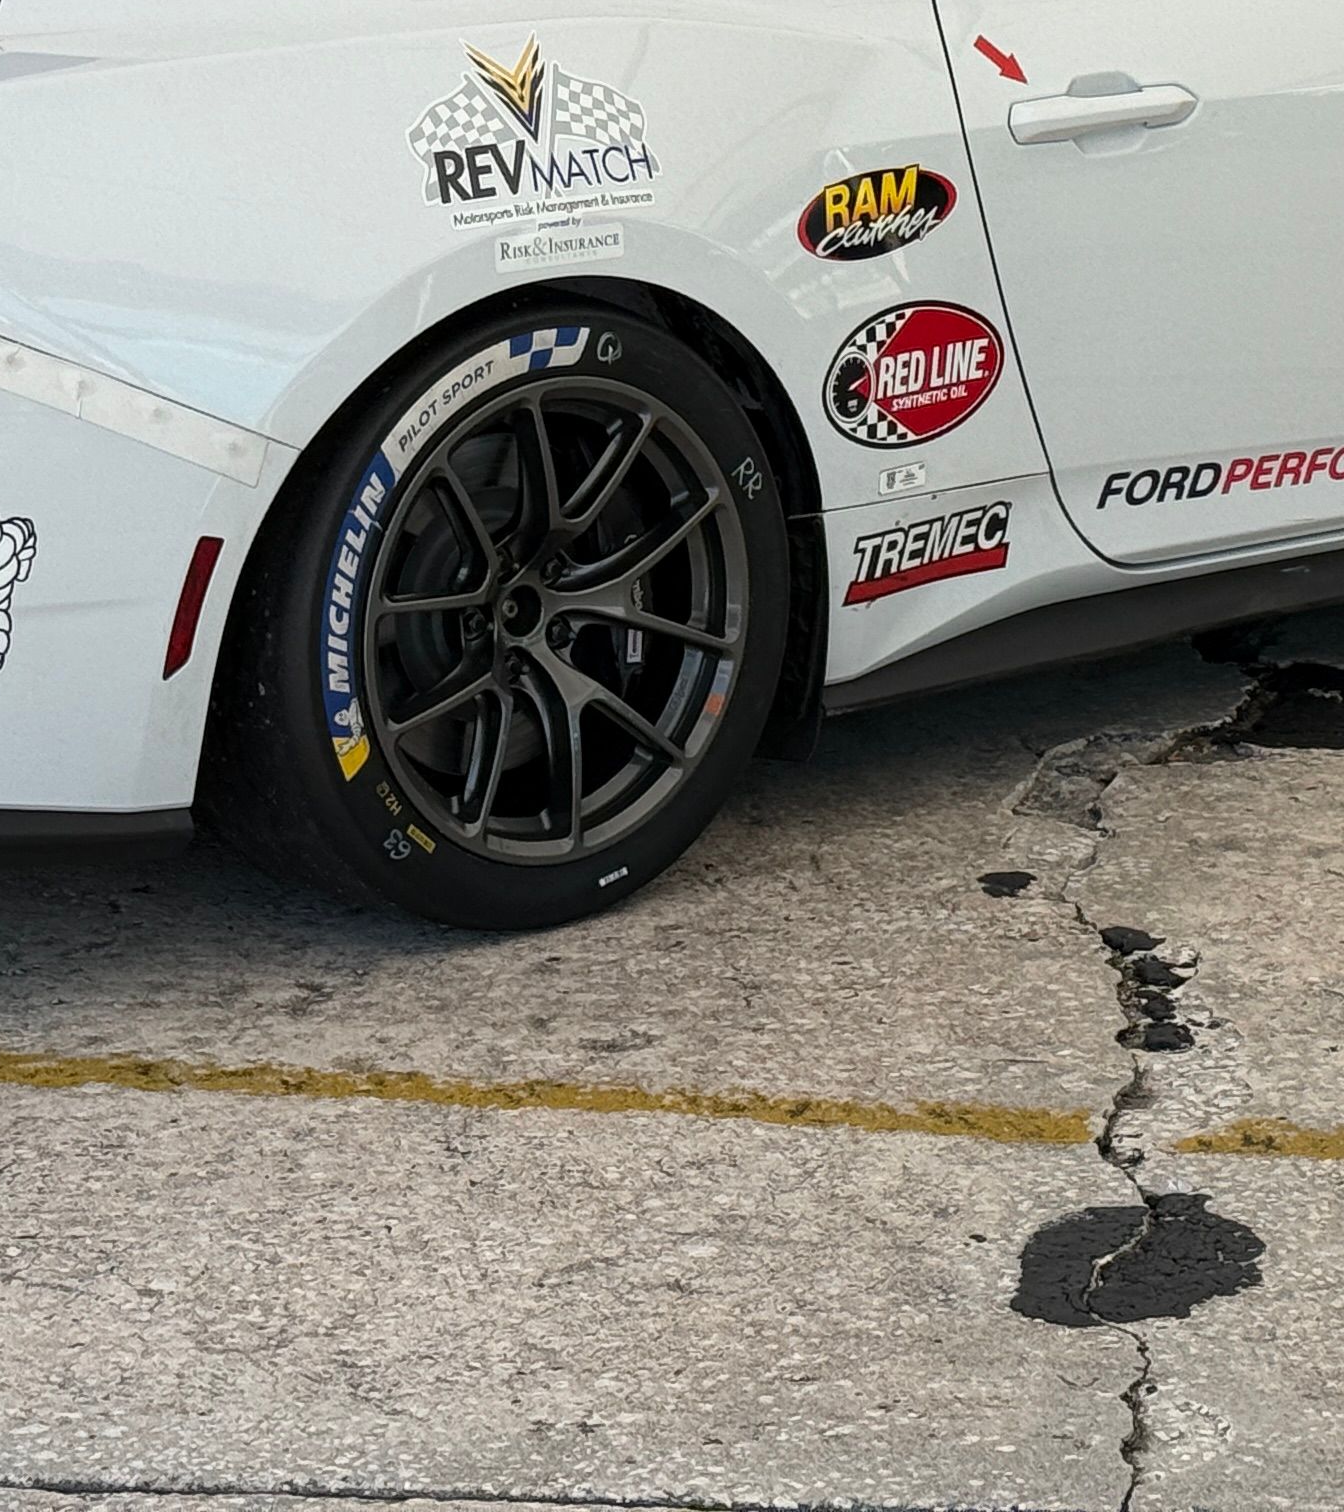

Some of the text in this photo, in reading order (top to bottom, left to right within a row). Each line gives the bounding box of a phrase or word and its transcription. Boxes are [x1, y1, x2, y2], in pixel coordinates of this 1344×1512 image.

[454, 209, 513, 227] Motorsports
[515, 201, 534, 216] Risk
[536, 194, 599, 214] Management
[611, 191, 653, 206] Insurance
[824, 167, 918, 233] RAM
[816, 204, 943, 257] Clutches
[876, 350, 926, 399] RED
[891, 384, 968, 411] SYNTHETIC OIL
[398, 359, 496, 453] PILOT SPORT
[731, 456, 763, 500] RR
[854, 500, 1009, 583] TREMEC
[327, 471, 386, 695] MICHELIN
